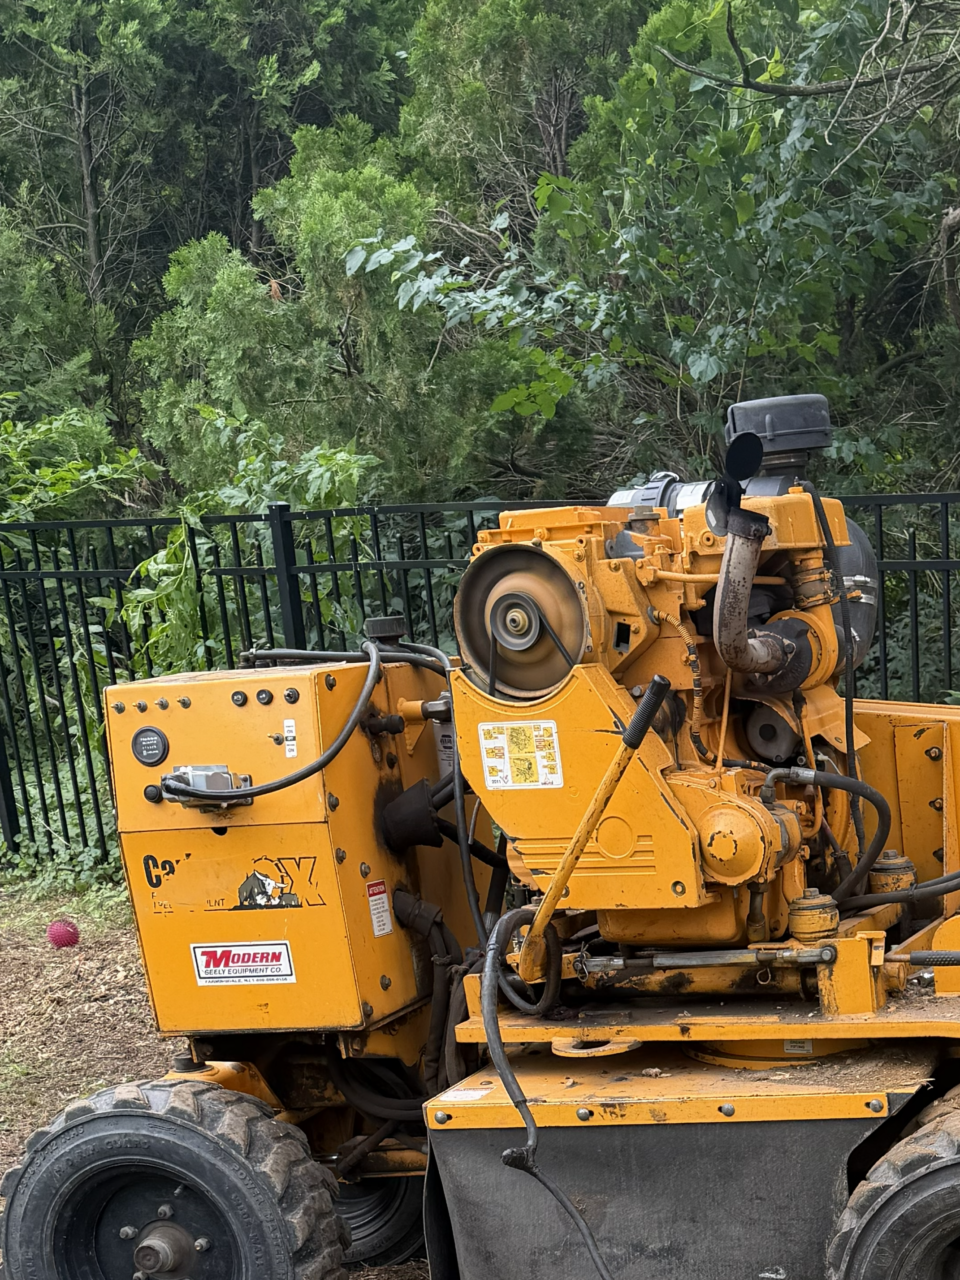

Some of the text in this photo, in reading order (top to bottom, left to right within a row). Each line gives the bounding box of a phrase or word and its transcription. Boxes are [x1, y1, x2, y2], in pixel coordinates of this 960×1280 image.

[201, 950, 282, 968] MODERN
[227, 967, 269, 975] EQUIPMENT
[270, 966, 283, 974] CO.
